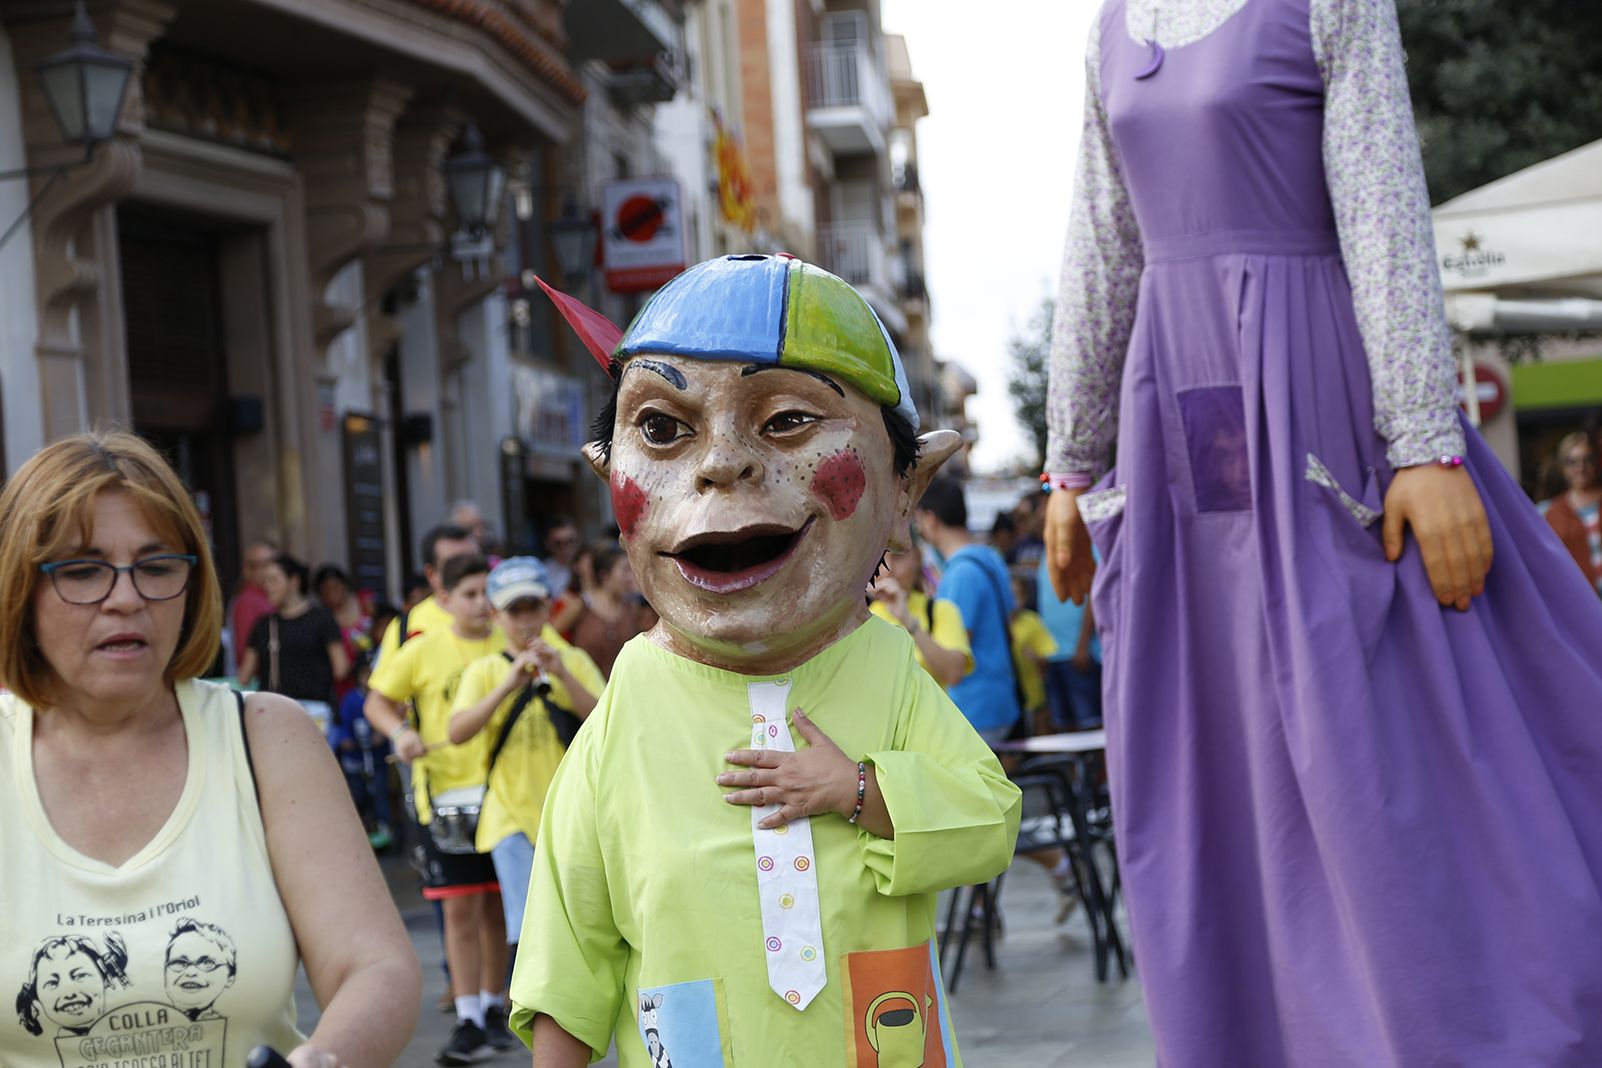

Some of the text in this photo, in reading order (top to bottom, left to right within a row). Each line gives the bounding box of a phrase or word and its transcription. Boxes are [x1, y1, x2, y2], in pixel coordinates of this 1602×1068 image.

[57, 895, 201, 927] La Teresina i l'Oriol
[108, 1008, 169, 1031] COLLA
[79, 1024, 204, 1062] GEGANTERA
